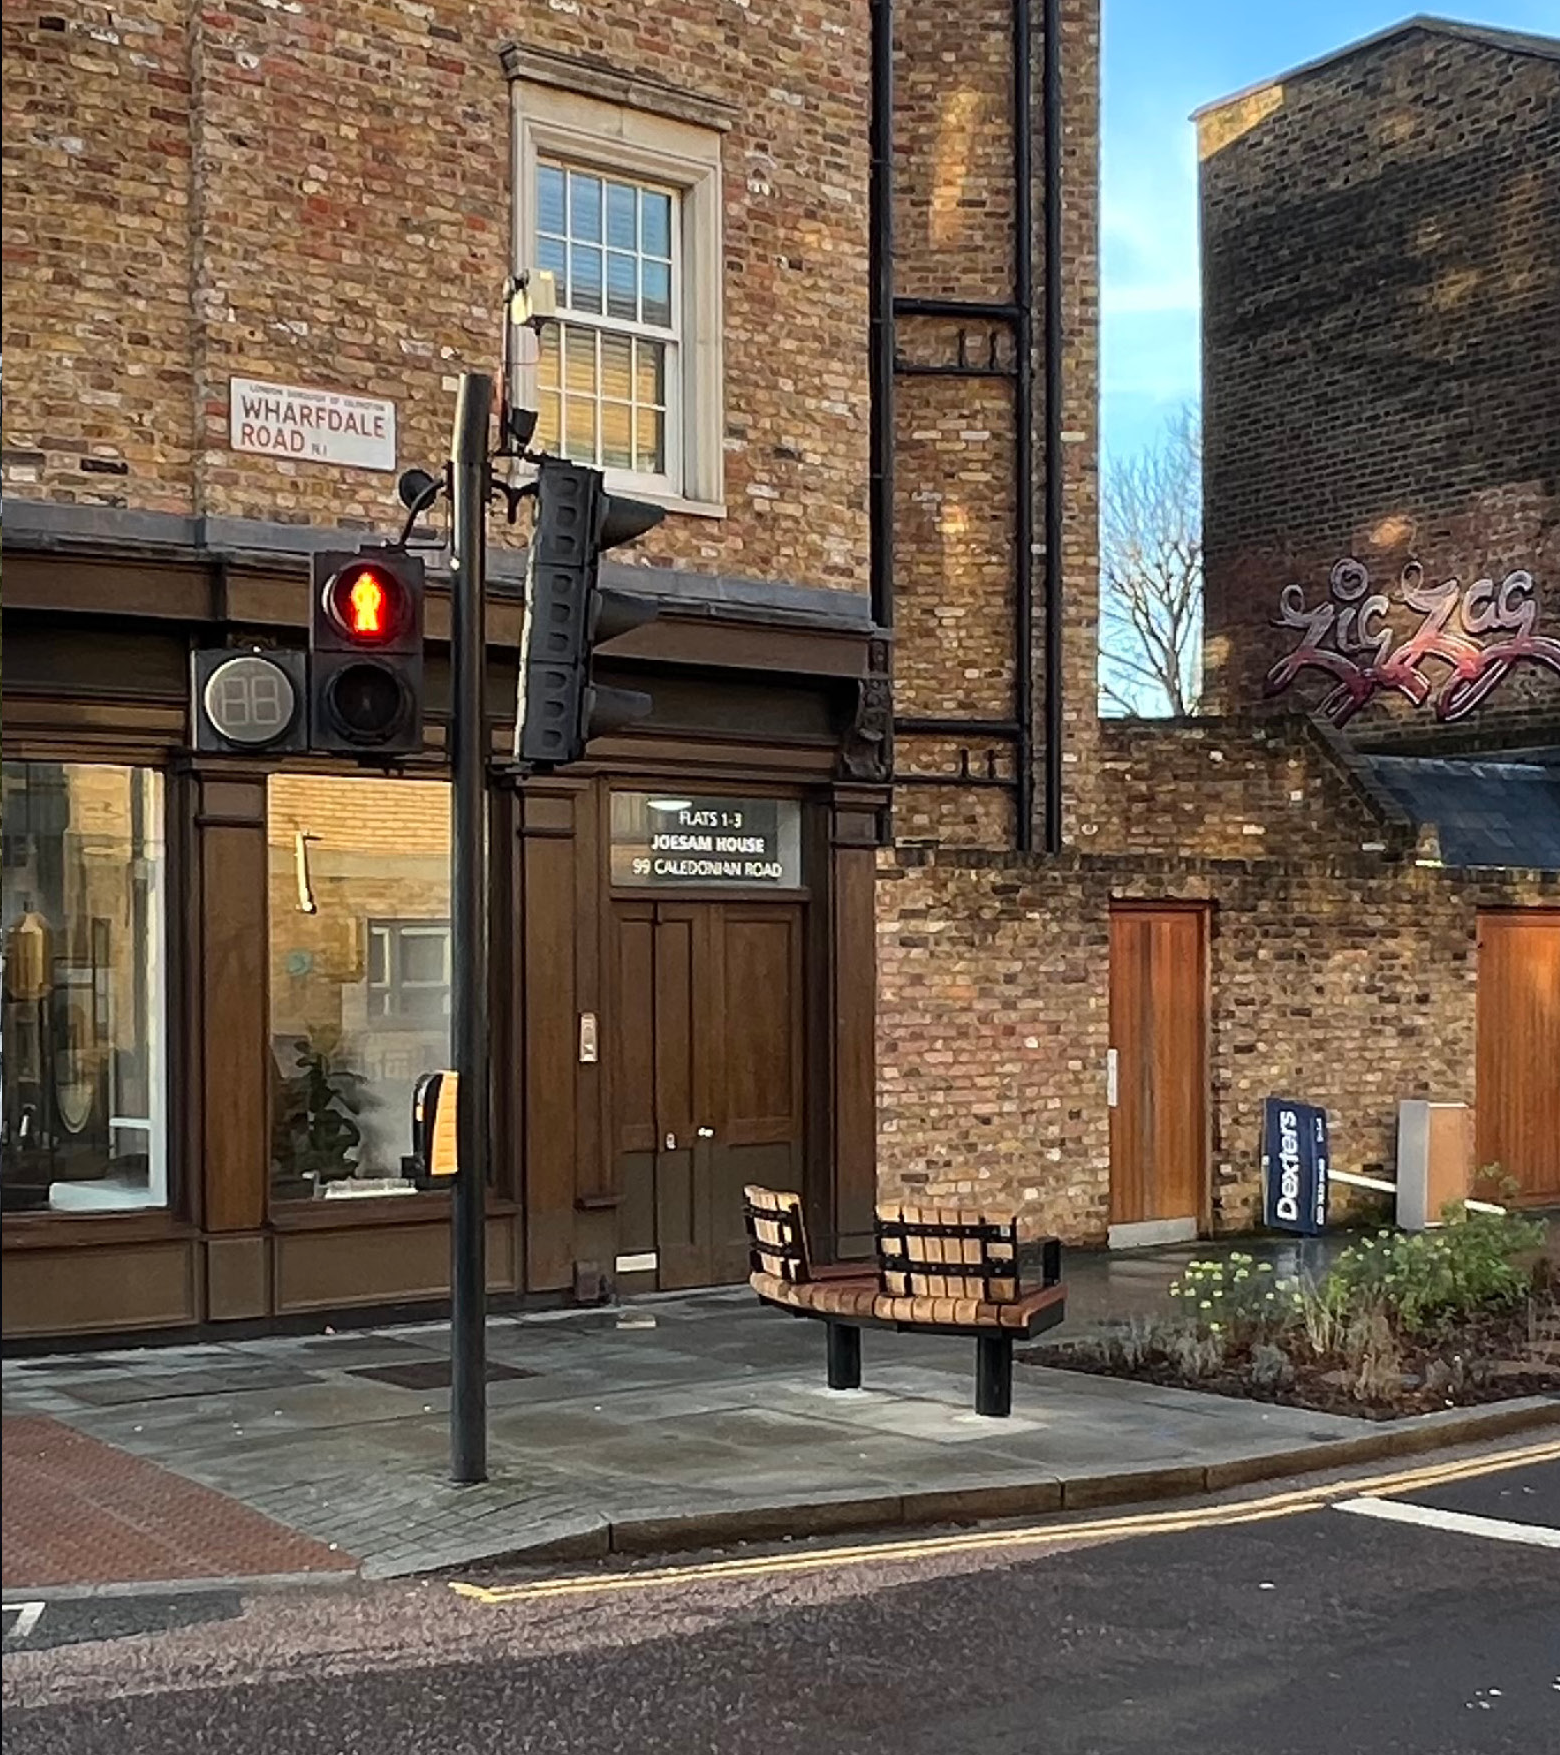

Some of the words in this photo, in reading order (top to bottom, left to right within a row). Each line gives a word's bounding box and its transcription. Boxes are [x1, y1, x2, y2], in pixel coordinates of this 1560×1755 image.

[241, 395, 386, 439] WHARFDALE
[241, 422, 305, 453] ROAD
[679, 810, 718, 827] FLATS
[721, 812, 743, 829] 1-3
[651, 834, 712, 852] JOESAM
[716, 836, 765, 853] HOUSE
[632, 858, 651, 875] 99
[654, 859, 742, 876] CALEDONIAN
[744, 861, 783, 878] ROAD
[1276, 1110, 1299, 1222] Dexters
